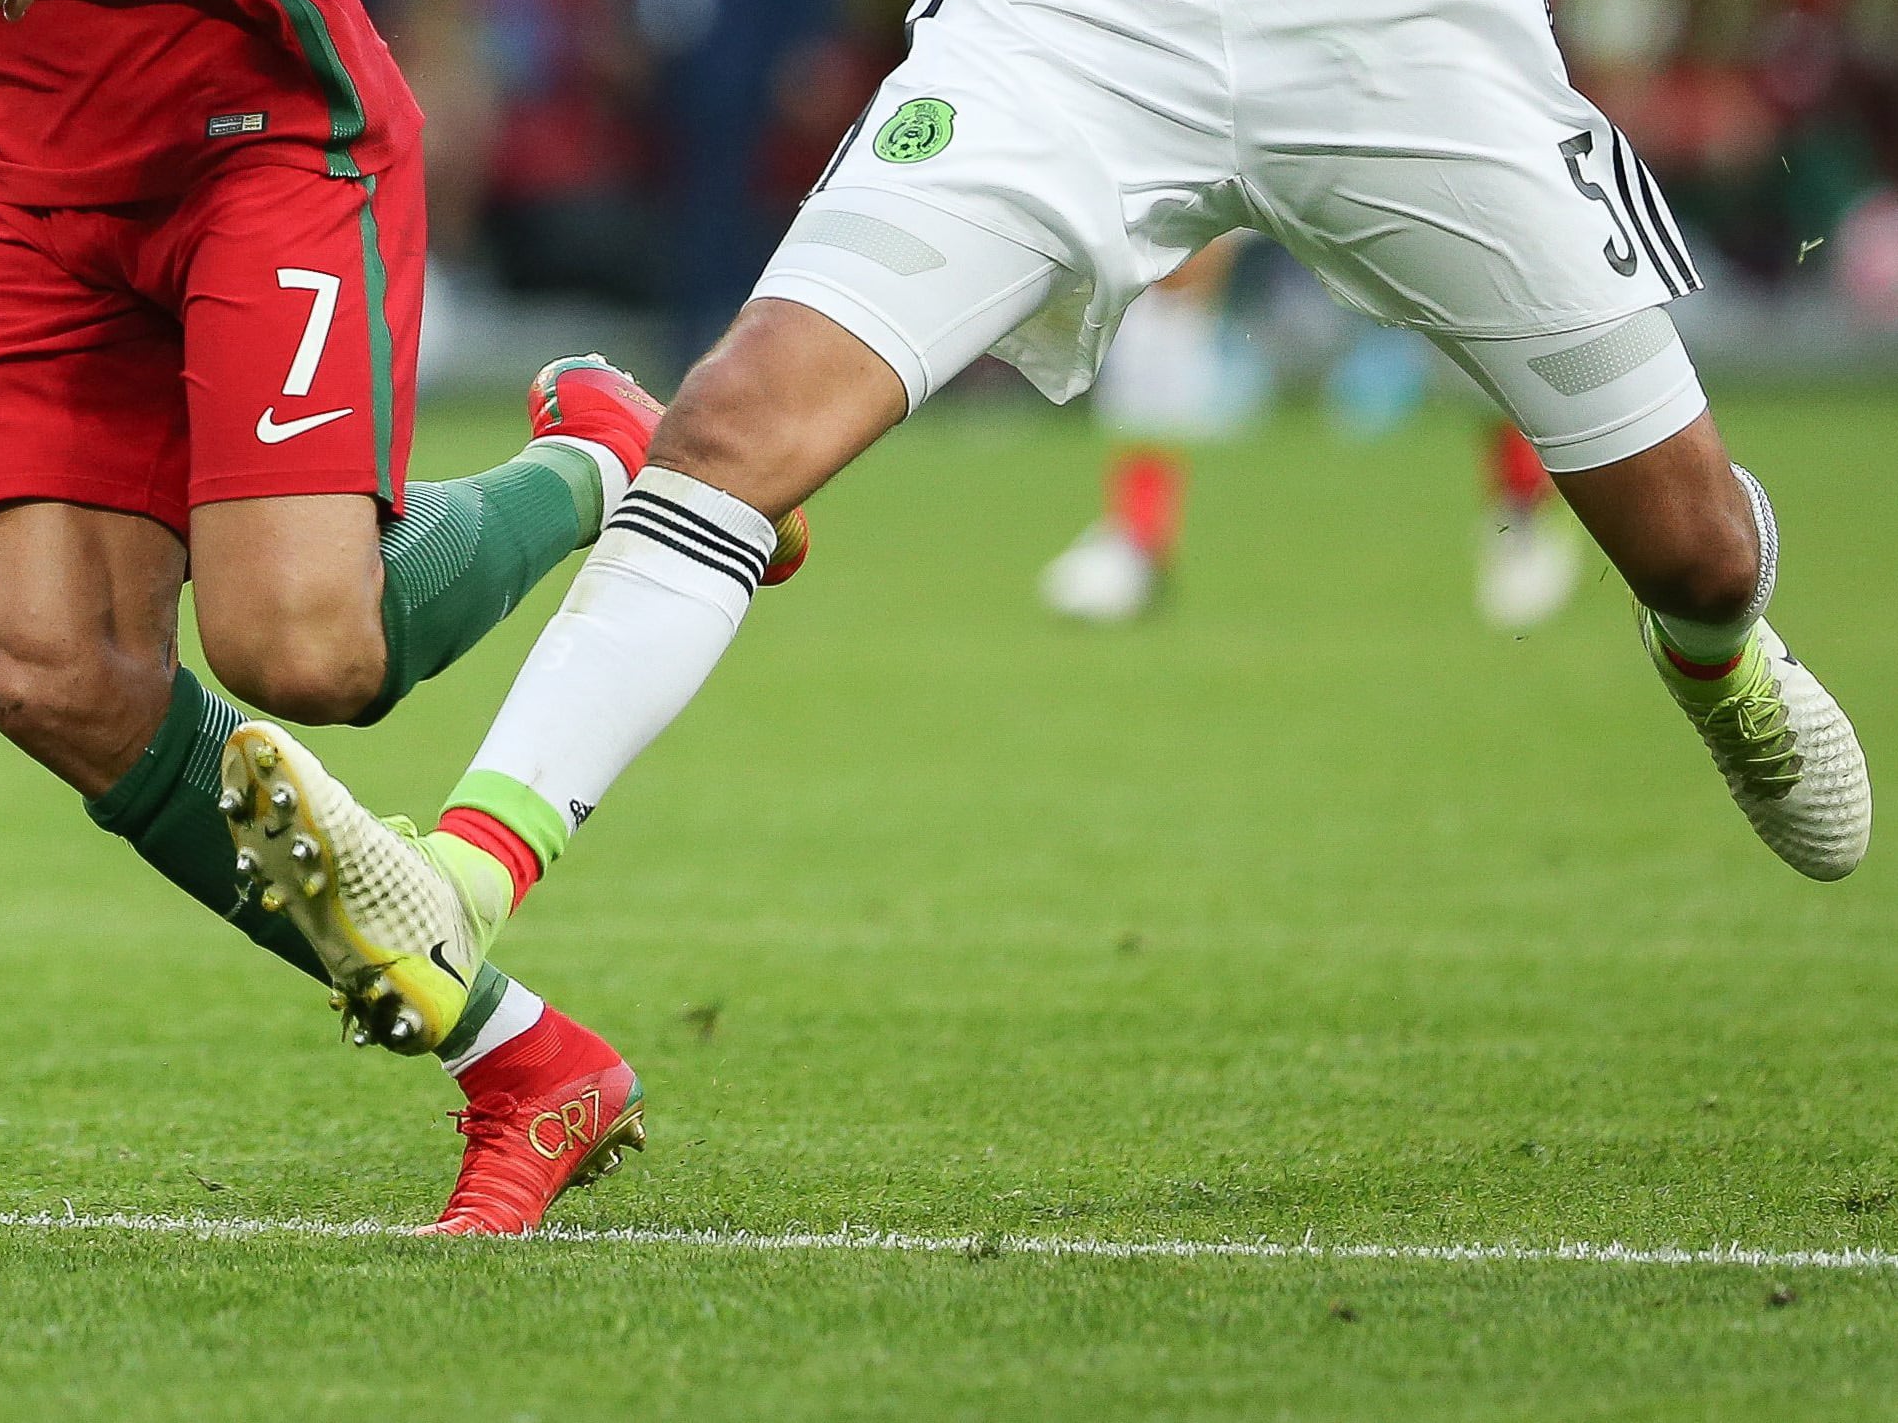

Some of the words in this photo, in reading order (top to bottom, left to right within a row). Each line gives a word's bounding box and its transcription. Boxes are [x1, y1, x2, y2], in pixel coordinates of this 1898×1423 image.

[1558, 130, 1638, 278] 5
[276, 267, 342, 396] 7
[528, 1088, 601, 1160] CR7
